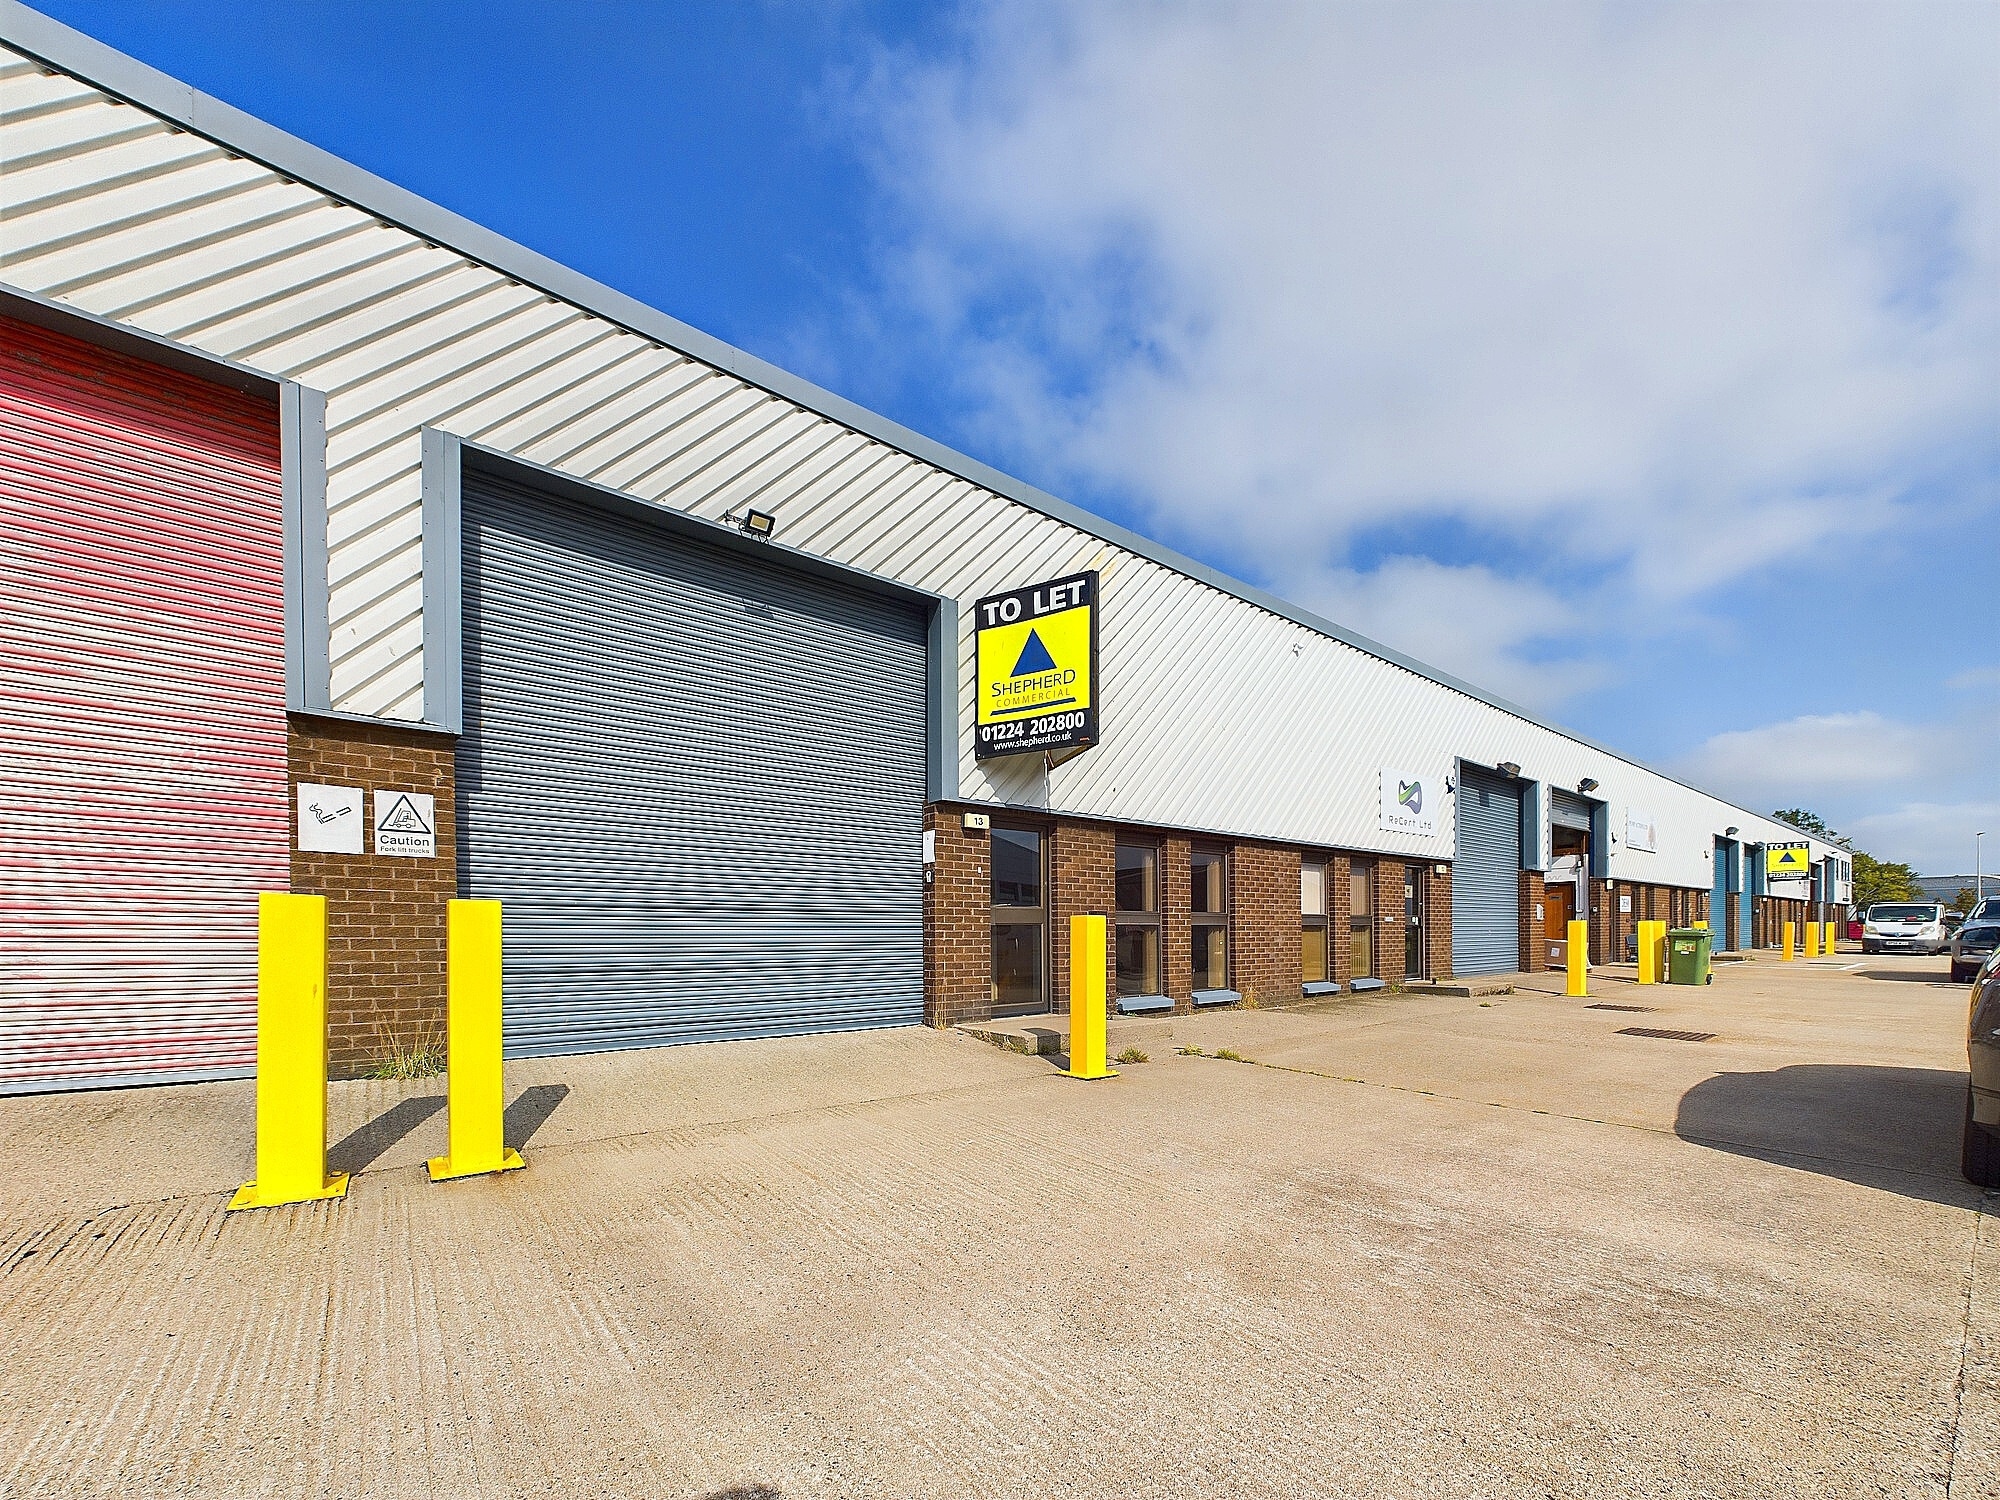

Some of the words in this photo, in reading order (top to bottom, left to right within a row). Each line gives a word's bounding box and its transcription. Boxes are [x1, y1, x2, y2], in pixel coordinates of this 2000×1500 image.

[983, 597, 1022, 625] TO
[1033, 580, 1086, 615] LET
[992, 669, 1076, 697] SHEPHERD
[996, 691, 1071, 707] COMMERCIAL
[981, 721, 1025, 742] 01224
[1030, 711, 1085, 736] 202800
[993, 731, 1072, 751] www.shepherd.co.uk
[974, 817, 984, 826] 13
[1388, 815, 1416, 827] ReCert
[1419, 819, 1432, 829] Ltd
[380, 834, 430, 846] Caution
